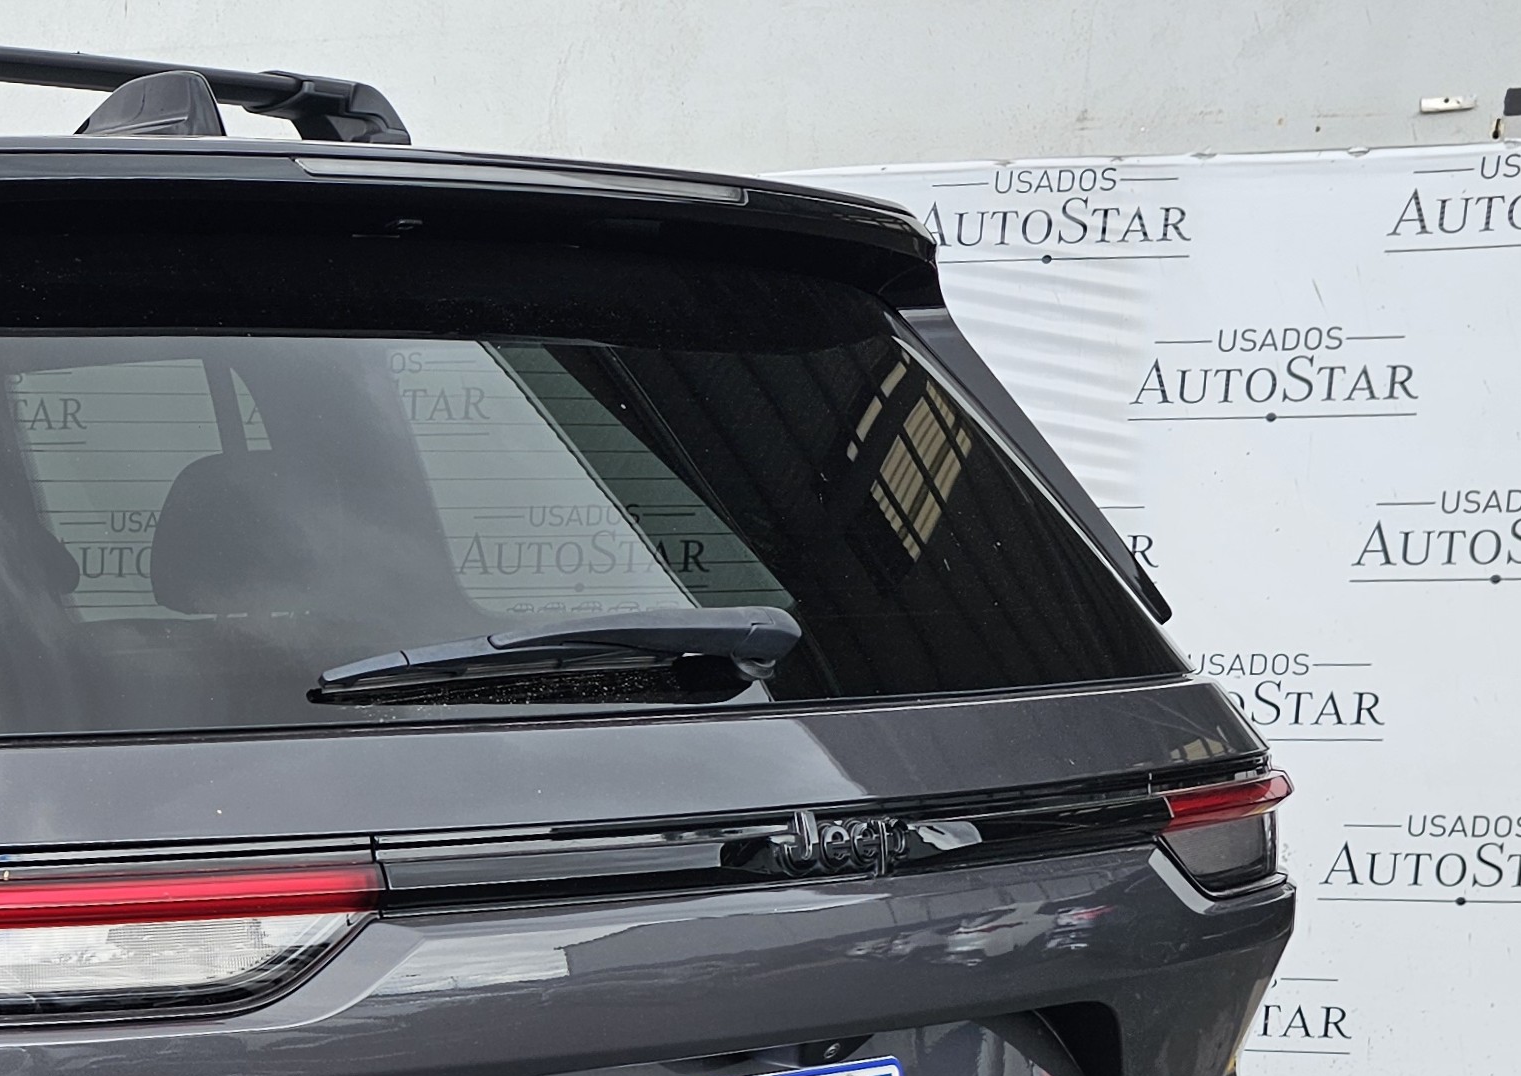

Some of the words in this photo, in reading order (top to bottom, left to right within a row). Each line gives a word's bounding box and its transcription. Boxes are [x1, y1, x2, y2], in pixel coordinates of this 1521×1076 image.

[994, 167, 1118, 194] USADOS
[1217, 326, 1344, 353] USADOS
[1128, 354, 1419, 405] AUTOSTAR
[775, 811, 909, 878] Jeep
